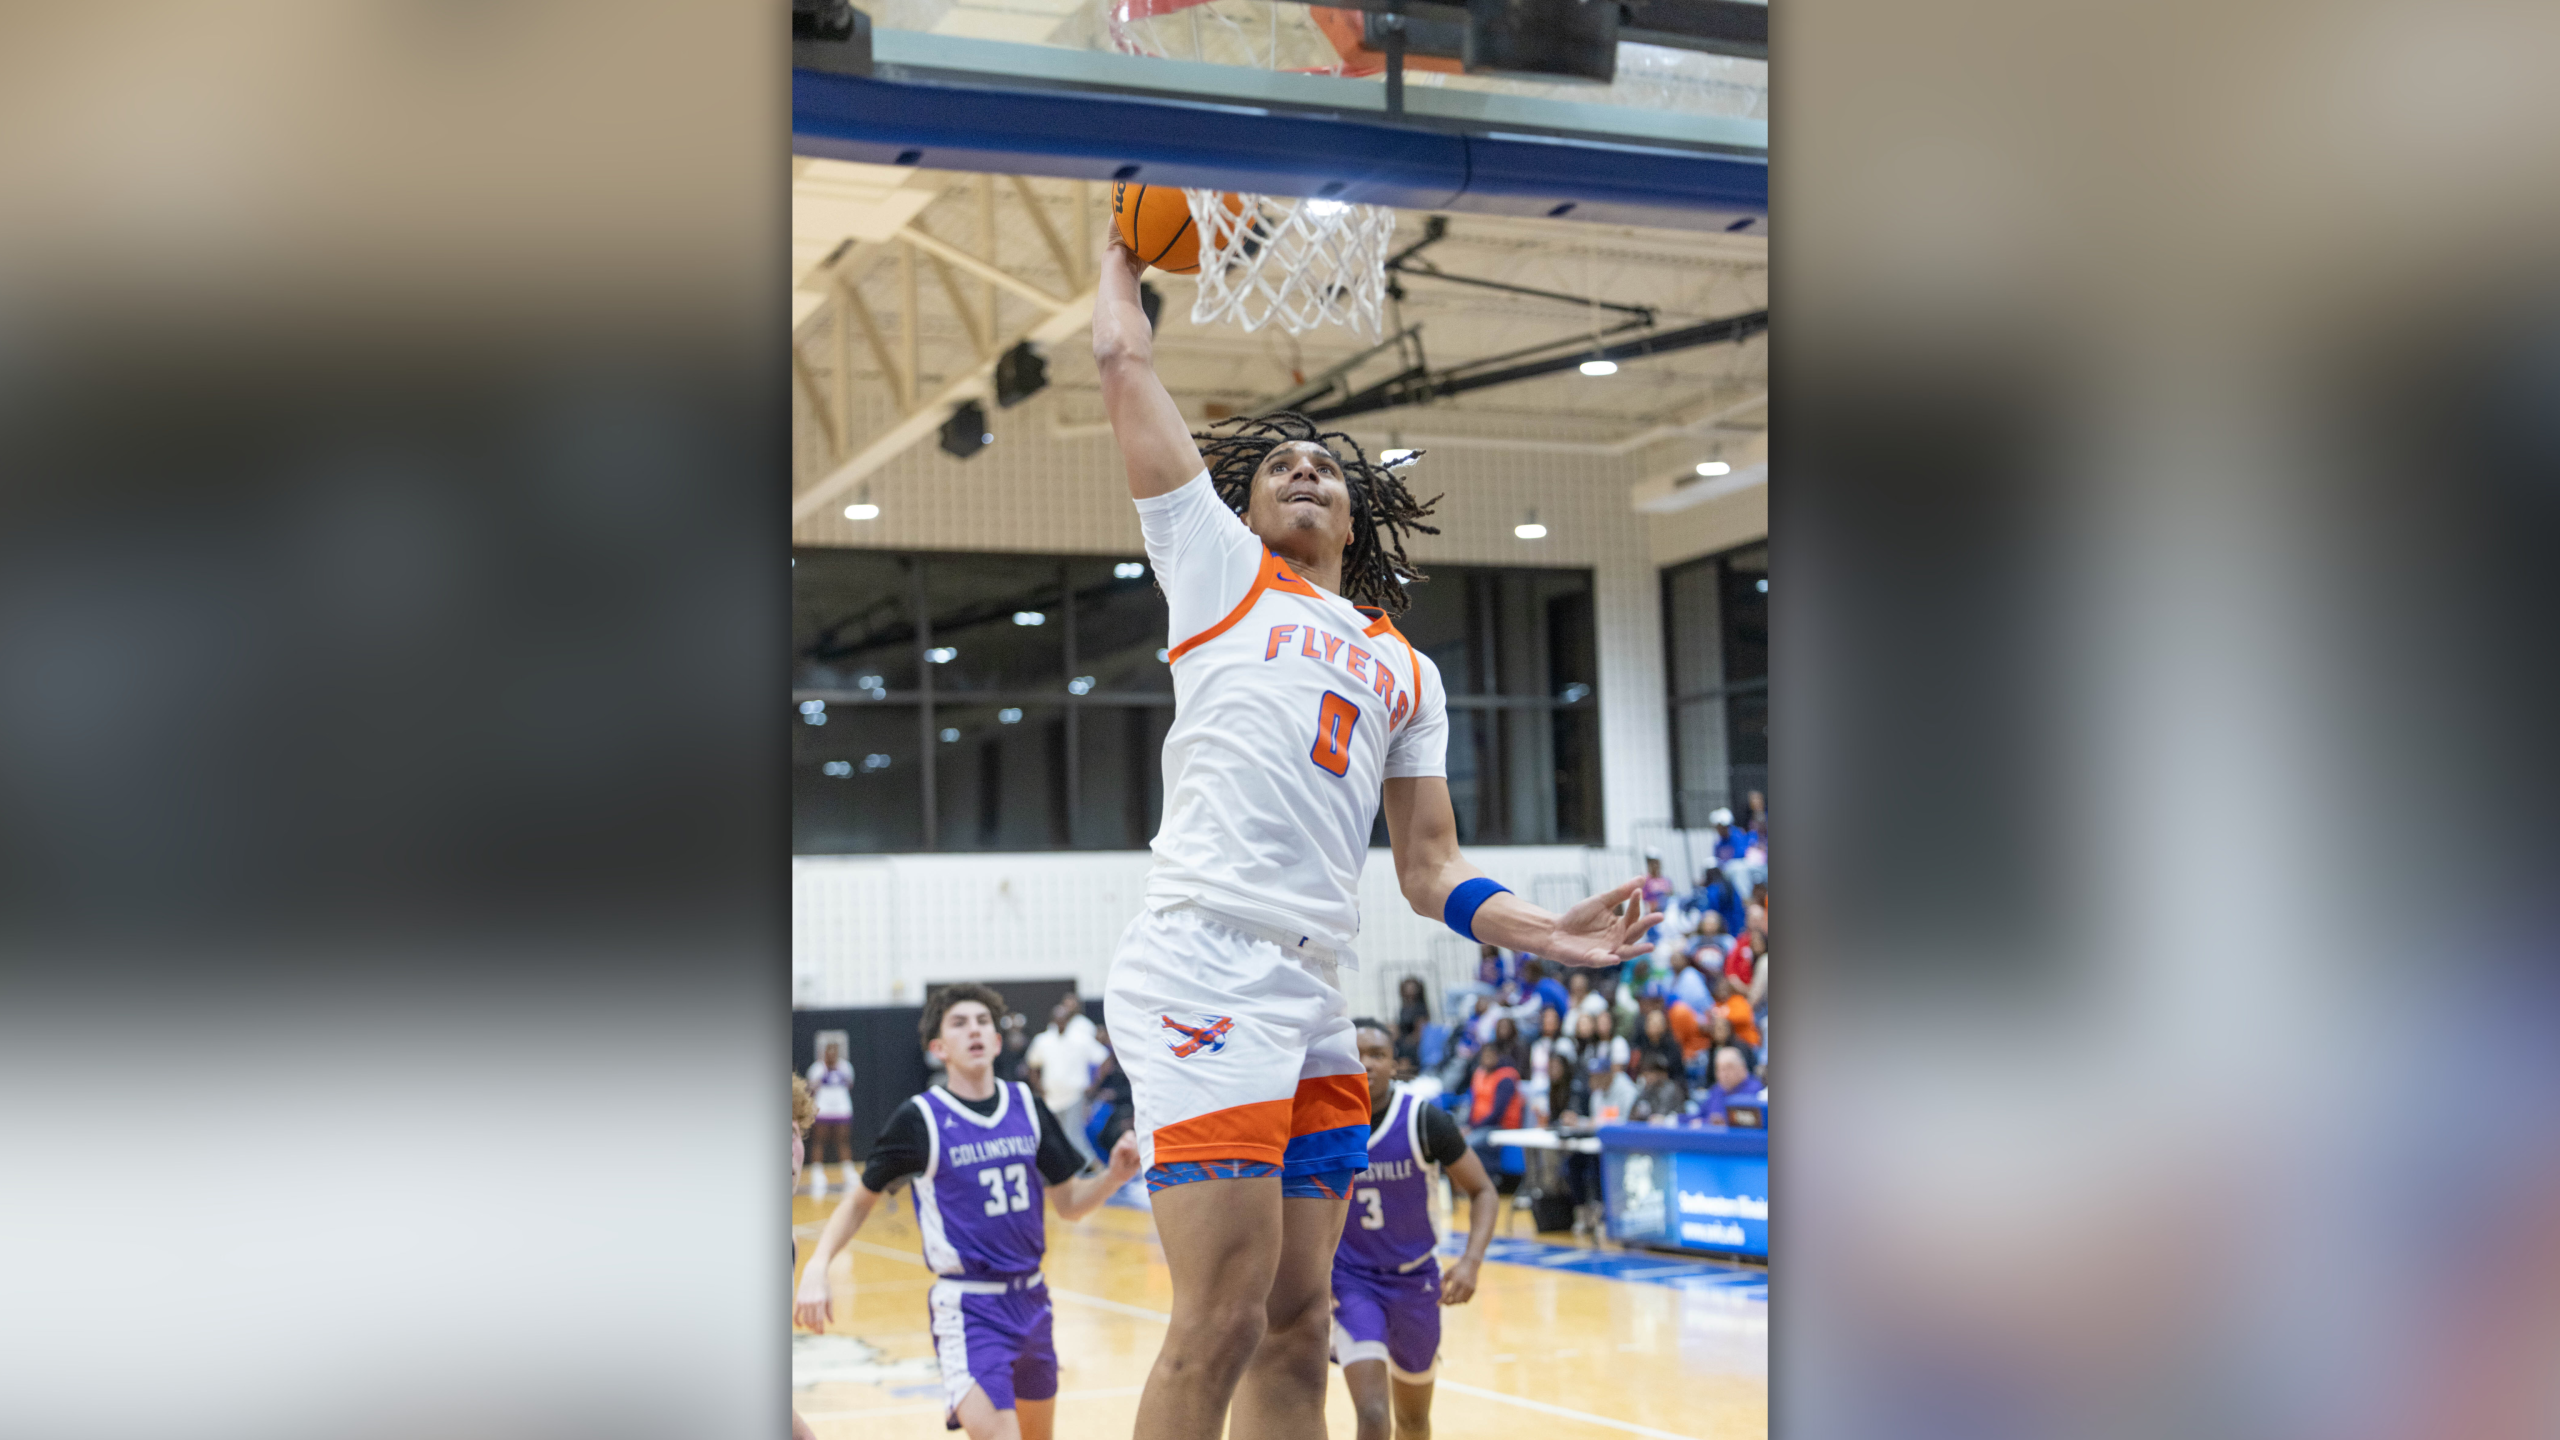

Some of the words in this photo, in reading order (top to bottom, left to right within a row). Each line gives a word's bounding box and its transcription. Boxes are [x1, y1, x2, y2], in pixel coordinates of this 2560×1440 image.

[1264, 624, 1409, 733] FLYERS
[1310, 690, 1361, 778] 0
[978, 1163, 1030, 1217] 33
[1356, 1187, 1385, 1230] 3
